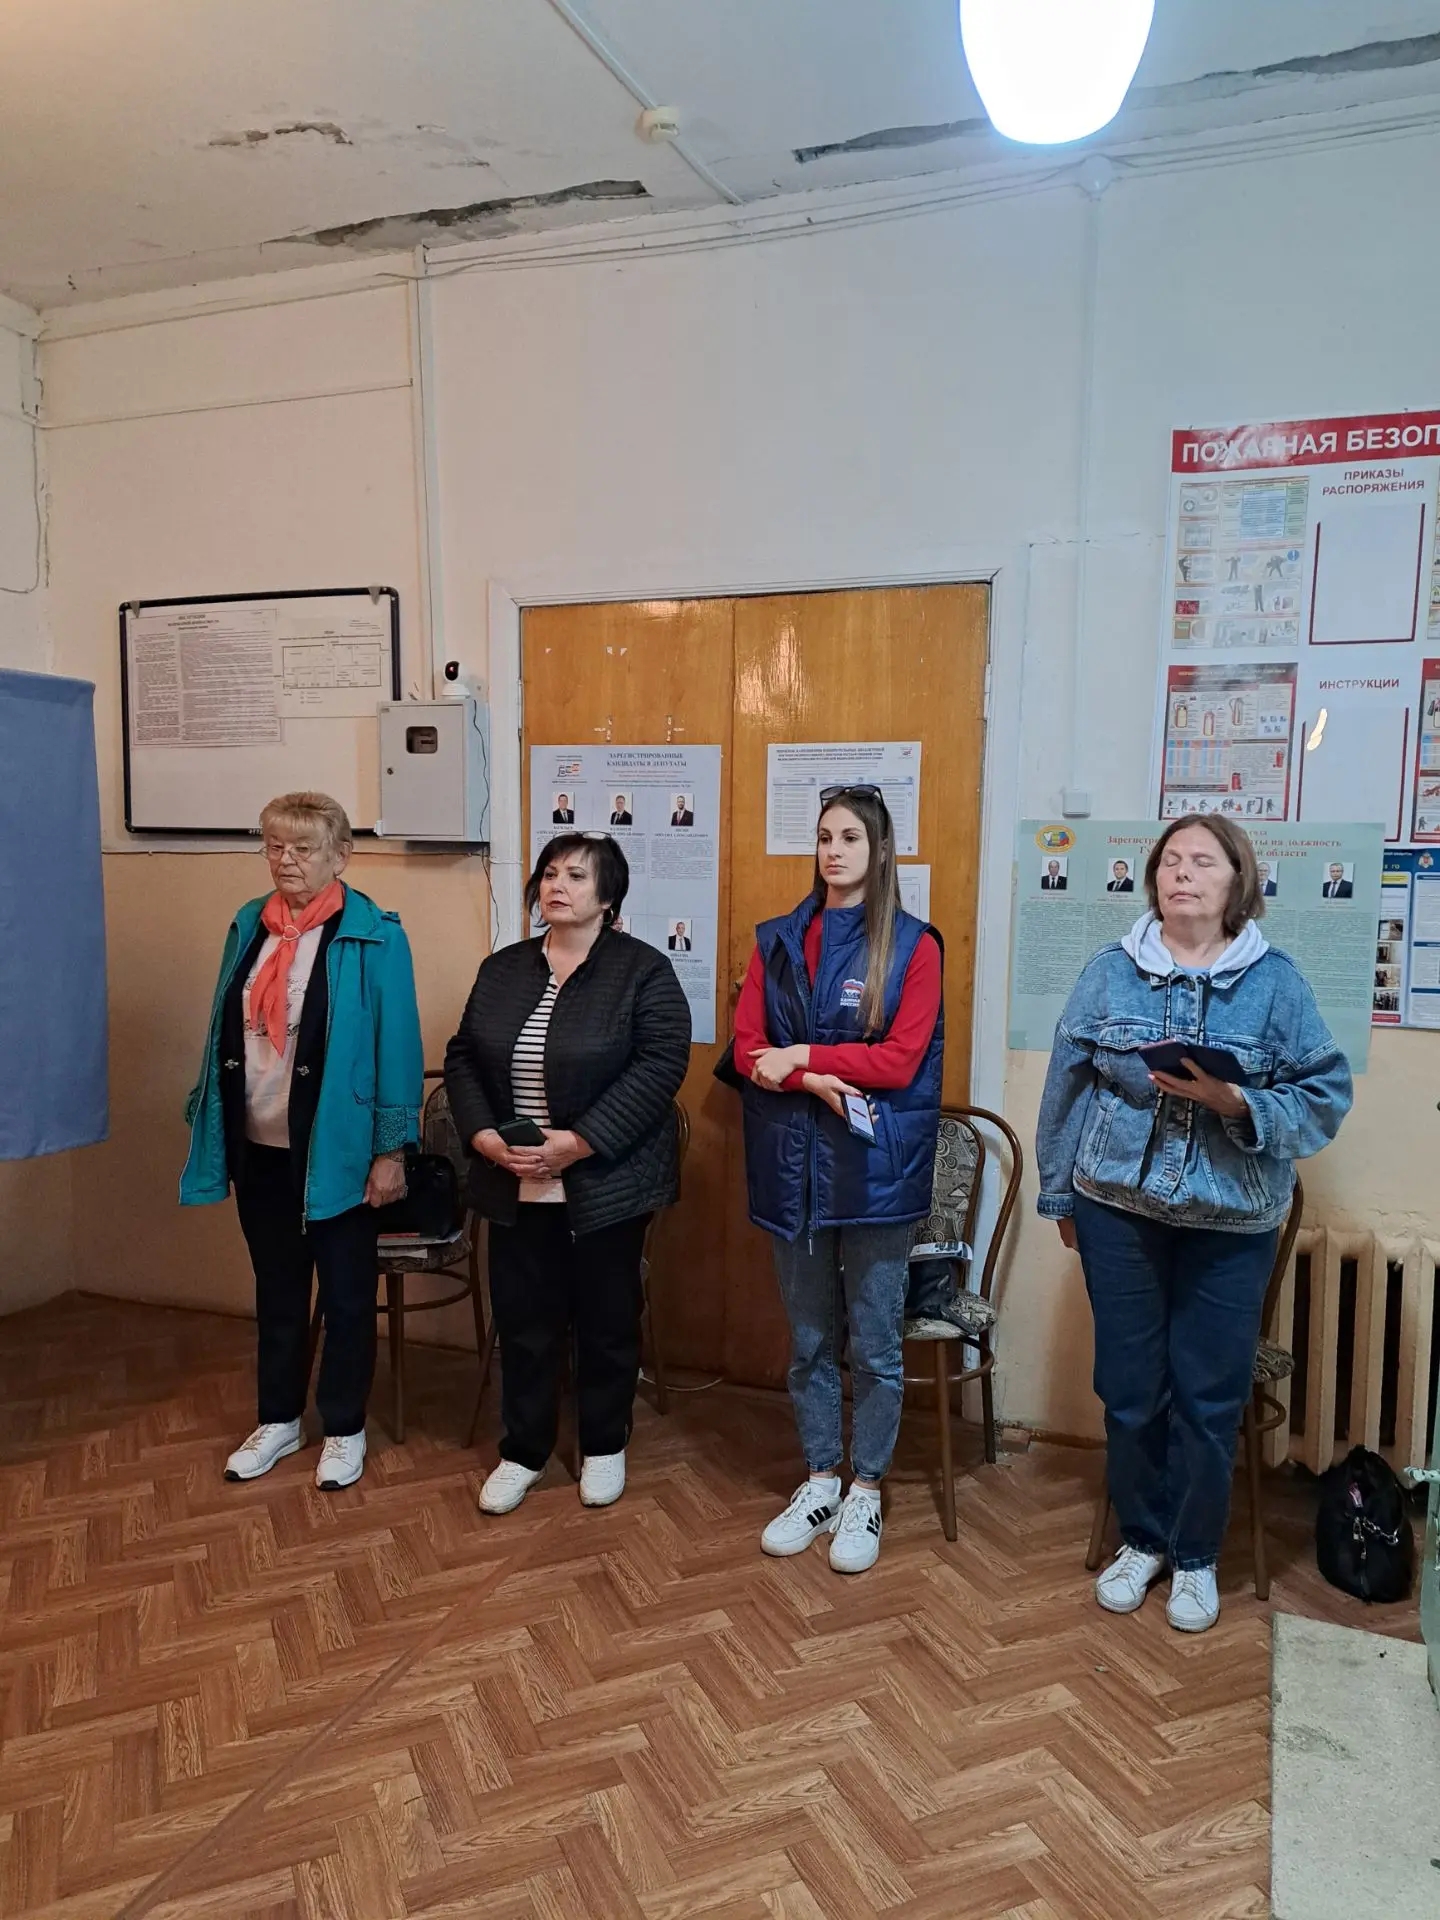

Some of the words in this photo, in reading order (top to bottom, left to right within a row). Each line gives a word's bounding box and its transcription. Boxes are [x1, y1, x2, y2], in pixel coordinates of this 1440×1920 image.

[1346, 424, 1440, 452] БЕЗОП
[1344, 468, 1404, 481] ПРИКАЗЫ
[1322, 480, 1425, 496] РАСПОРЯЖЕНИЯ
[1319, 678, 1400, 690] ИНСТРУКЦИИ
[608, 752, 684, 760] ЗАРЕГИСТРИРОВАННЫЕ
[653, 760, 687, 768] ДЕПУТАТЫ
[1286, 839, 1342, 848] должность
[1265, 848, 1307, 857] области
